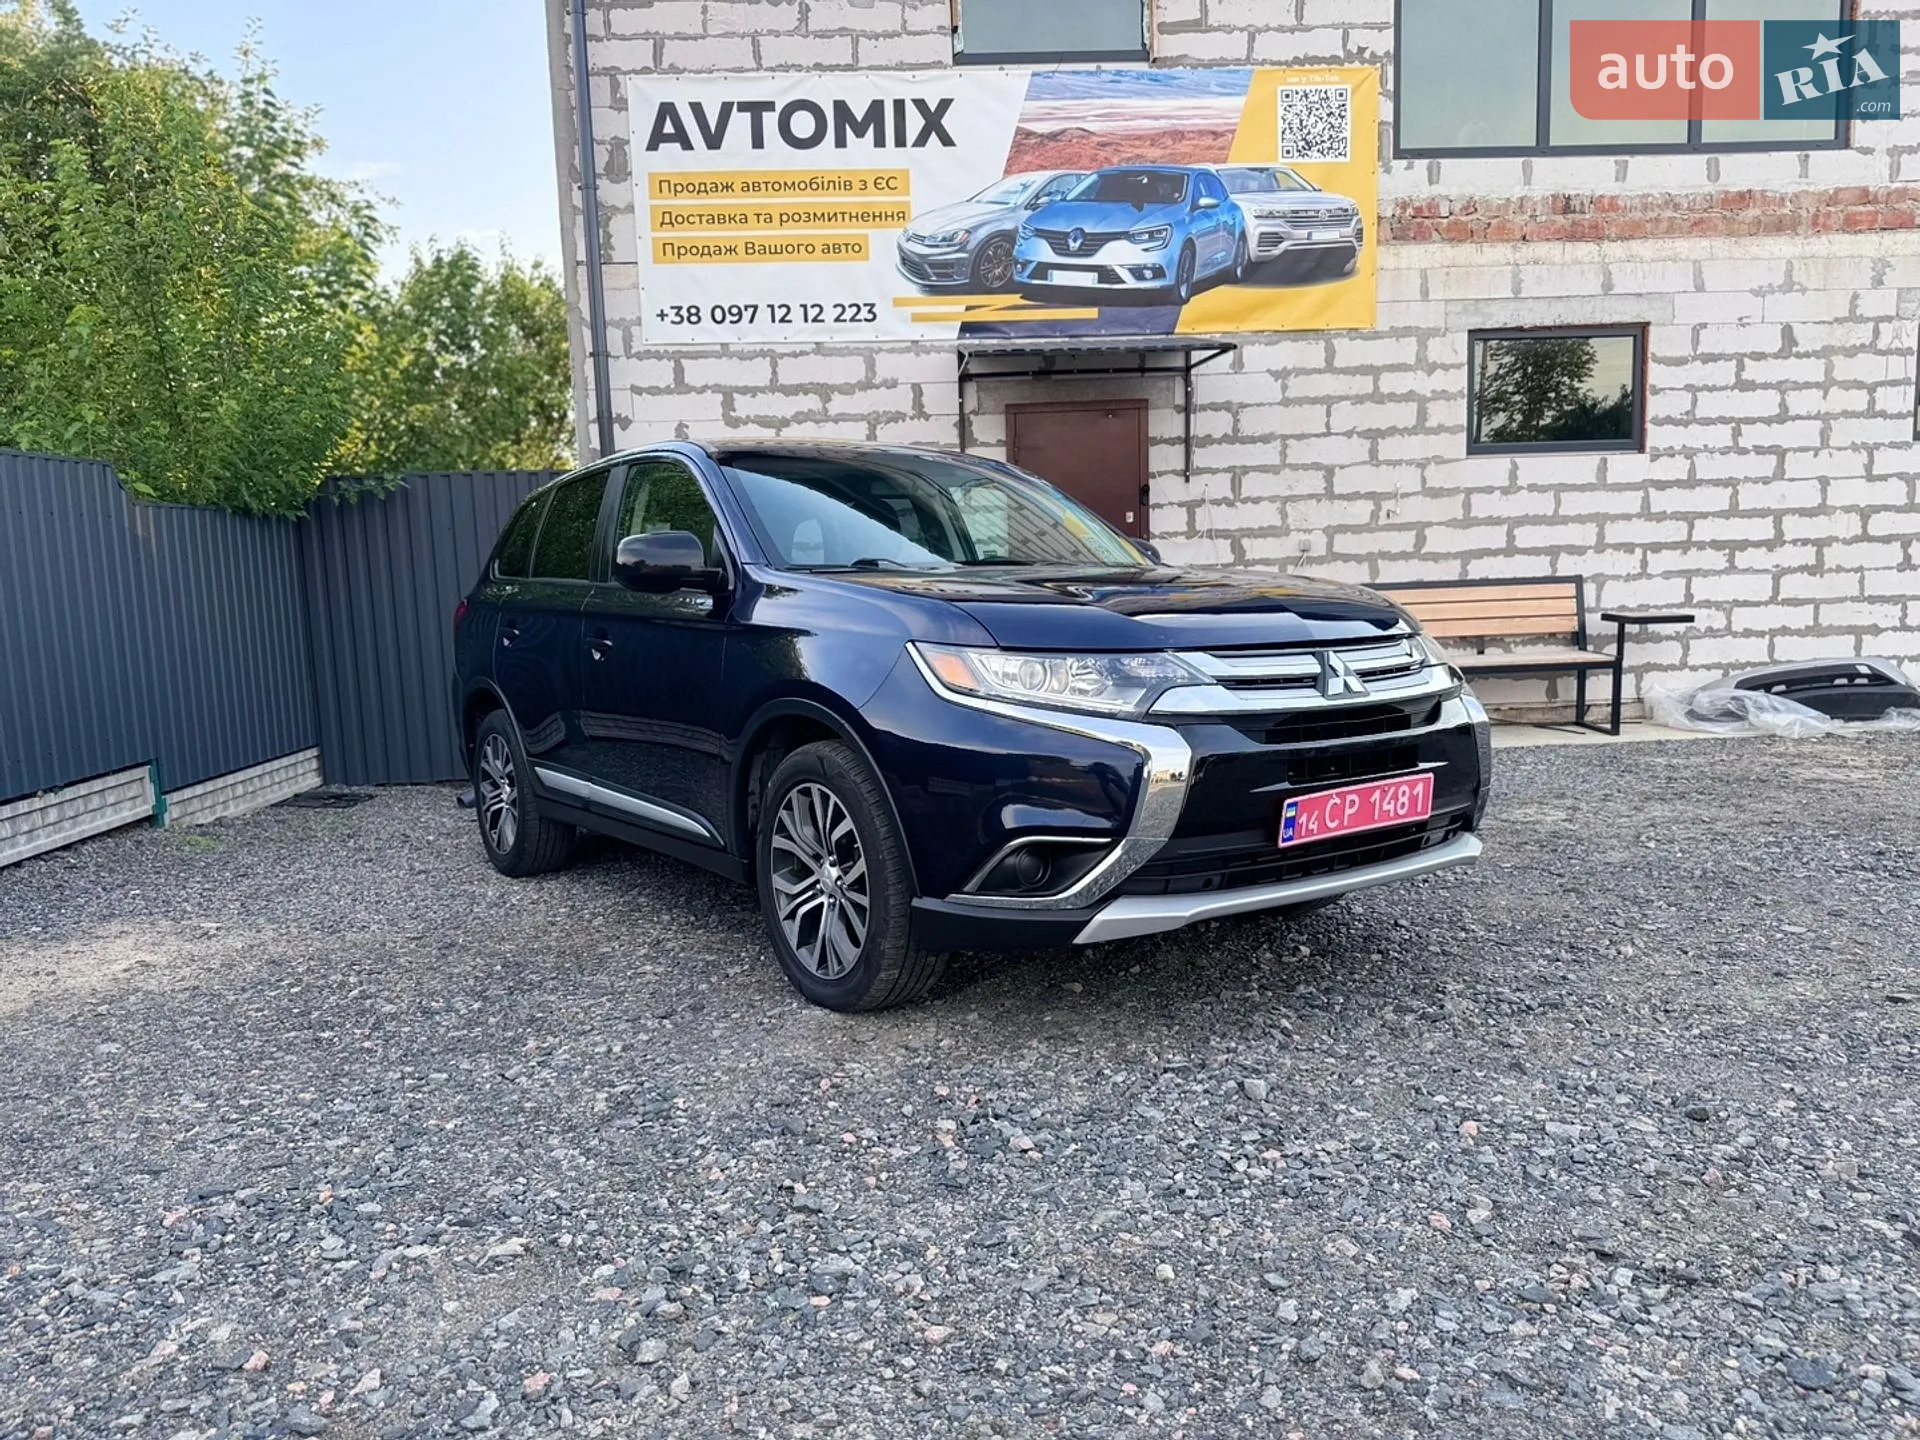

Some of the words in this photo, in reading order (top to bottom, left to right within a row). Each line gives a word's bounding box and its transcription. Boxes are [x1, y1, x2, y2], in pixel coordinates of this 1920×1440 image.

[645, 98, 957, 151] AVTOMIX
[658, 179, 735, 197] Продаж
[741, 176, 853, 192] автомобілів
[858, 179, 868, 191] з
[873, 176, 898, 191] ЄС
[660, 211, 748, 228] Доставка
[753, 213, 773, 224] та
[779, 211, 906, 227] розмитнення
[662, 242, 739, 260] Продаж
[745, 241, 816, 255] Вашого
[821, 242, 862, 255] авто
[656, 305, 701, 325] +38
[710, 304, 759, 324] 097
[767, 303, 793, 324] 12
[800, 303, 825, 323] 12
[832, 302, 878, 323] 223
[1298, 809, 1320, 837] 14
[1369, 781, 1424, 820] 1481
